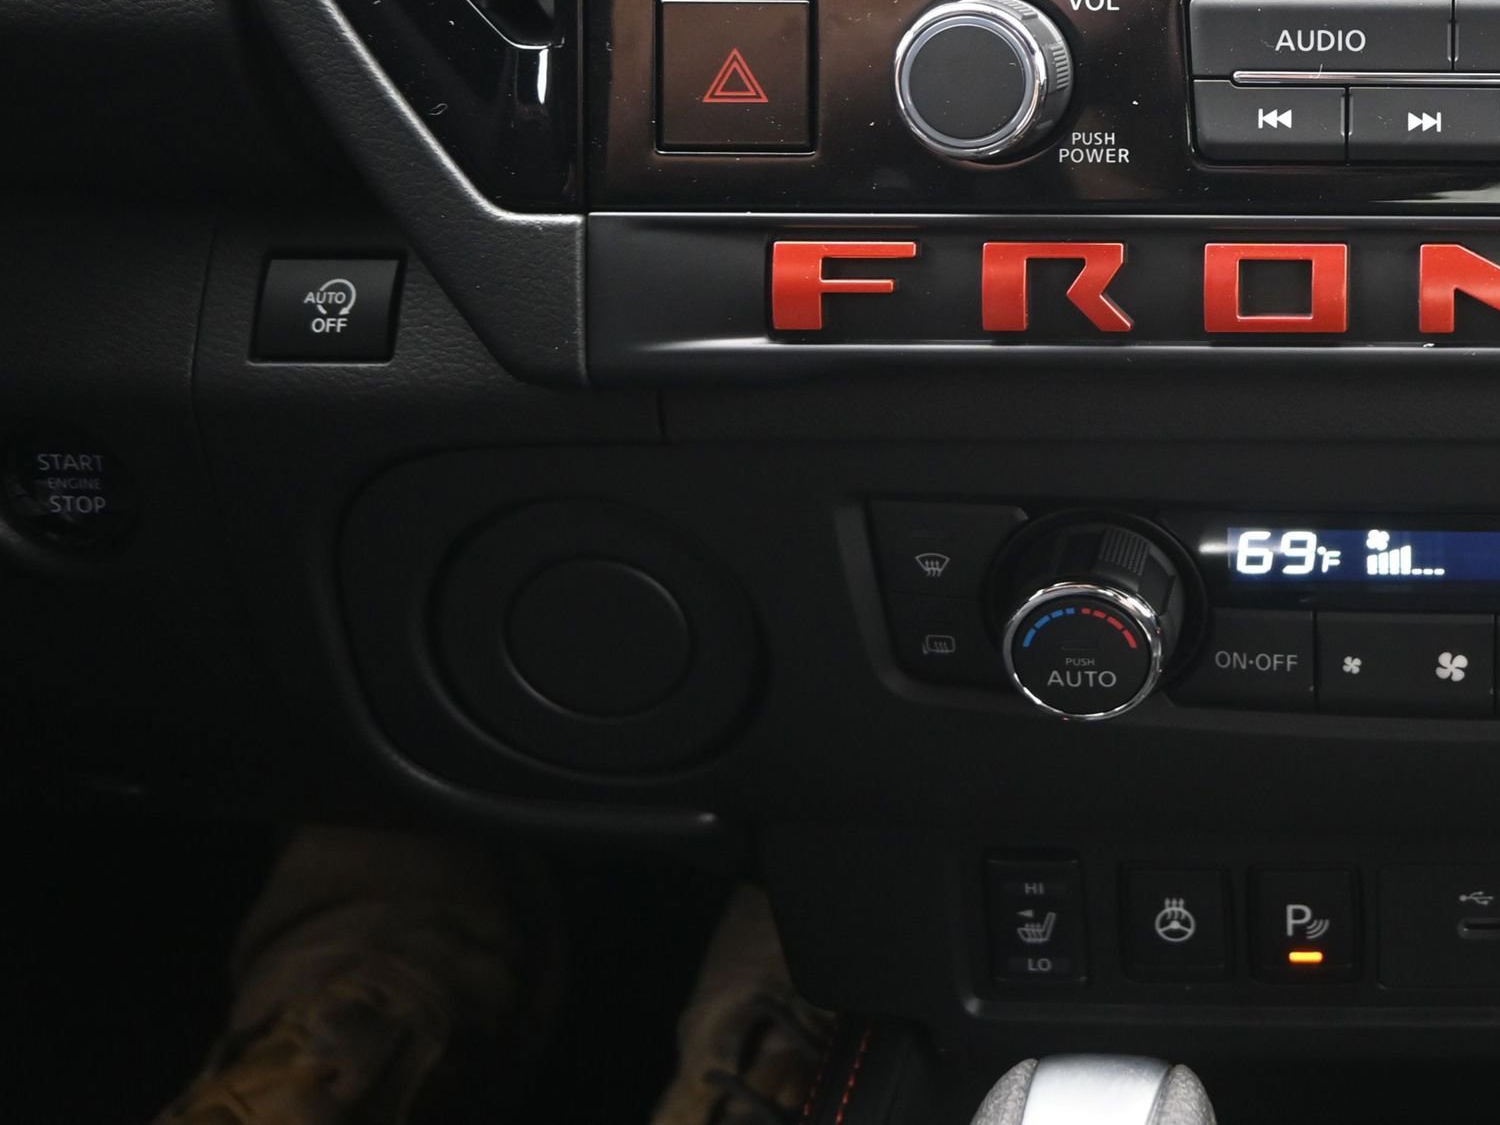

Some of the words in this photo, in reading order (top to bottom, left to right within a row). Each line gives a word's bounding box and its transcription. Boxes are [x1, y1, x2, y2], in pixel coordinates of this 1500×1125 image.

[1275, 30, 1366, 52] AUDIO
[1072, 133, 1115, 146] PUSH
[1059, 148, 1130, 164] POWER
[304, 292, 346, 305] AUTO
[312, 318, 347, 333] OFF
[37, 453, 104, 472] START
[47, 476, 102, 490] ENGINE
[49, 495, 106, 514] STOP
[1065, 657, 1096, 666] PUSH
[1046, 669, 1117, 688] AUTO
[1025, 883, 1044, 895] HI
[1028, 959, 1052, 972] LO
